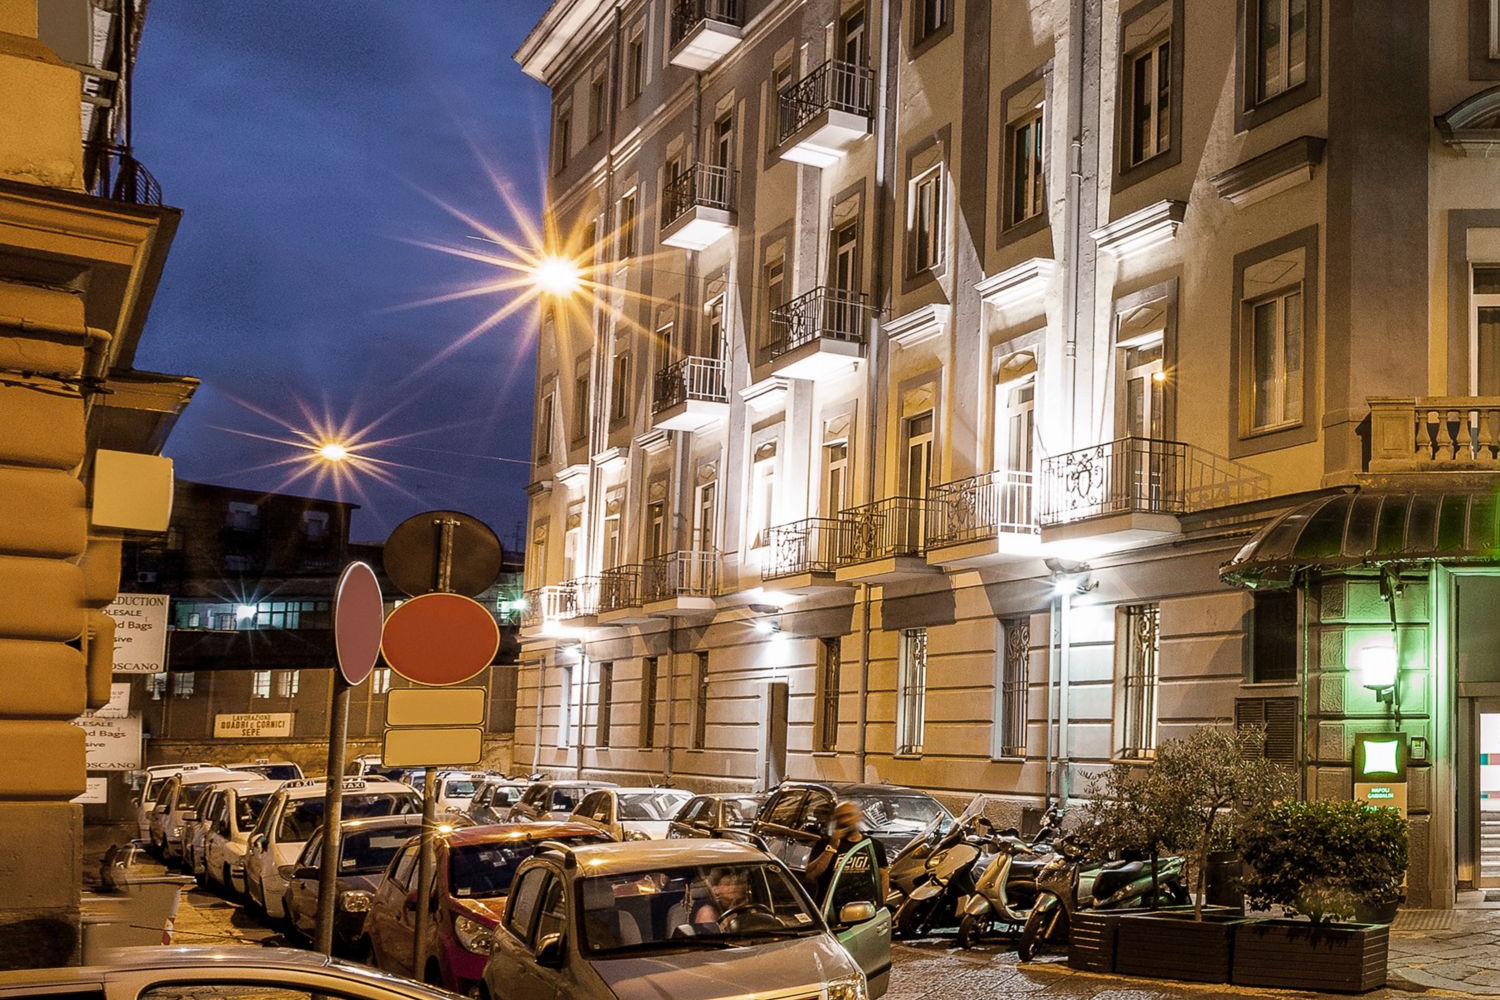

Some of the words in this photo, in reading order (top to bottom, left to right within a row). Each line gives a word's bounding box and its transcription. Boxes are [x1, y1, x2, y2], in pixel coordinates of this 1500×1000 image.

[128, 621, 153, 631] Bags
[221, 721, 249, 729] QUADRI
[256, 720, 285, 729] CORNICI
[100, 731, 126, 739] Bags
[241, 728, 261, 736] SEPE
[289, 780, 315, 788] TAXI
